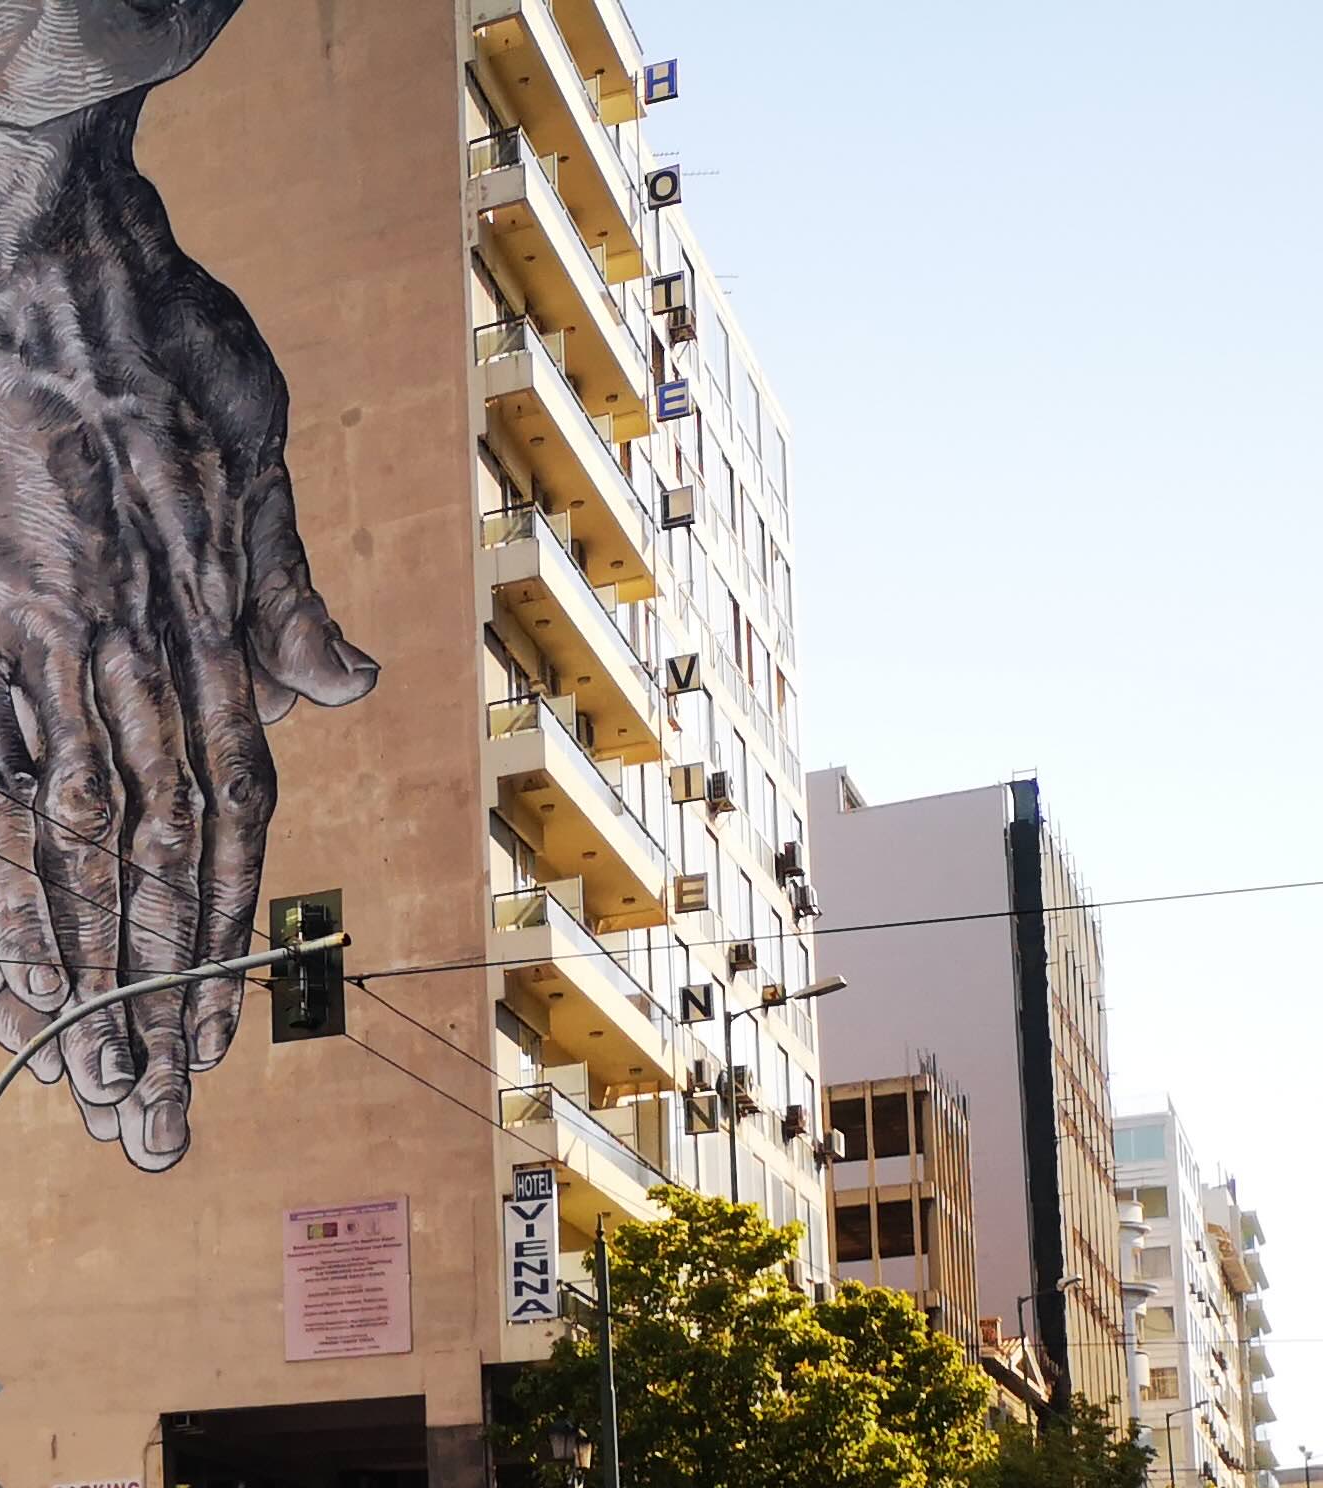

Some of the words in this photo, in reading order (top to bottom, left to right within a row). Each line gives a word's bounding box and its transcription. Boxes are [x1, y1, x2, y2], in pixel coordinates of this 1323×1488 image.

[646, 62, 692, 527] HOTEL
[670, 656, 717, 1134] VIENN
[517, 1173, 552, 1198] HOTEL
[510, 1202, 553, 1317] VIENNA
